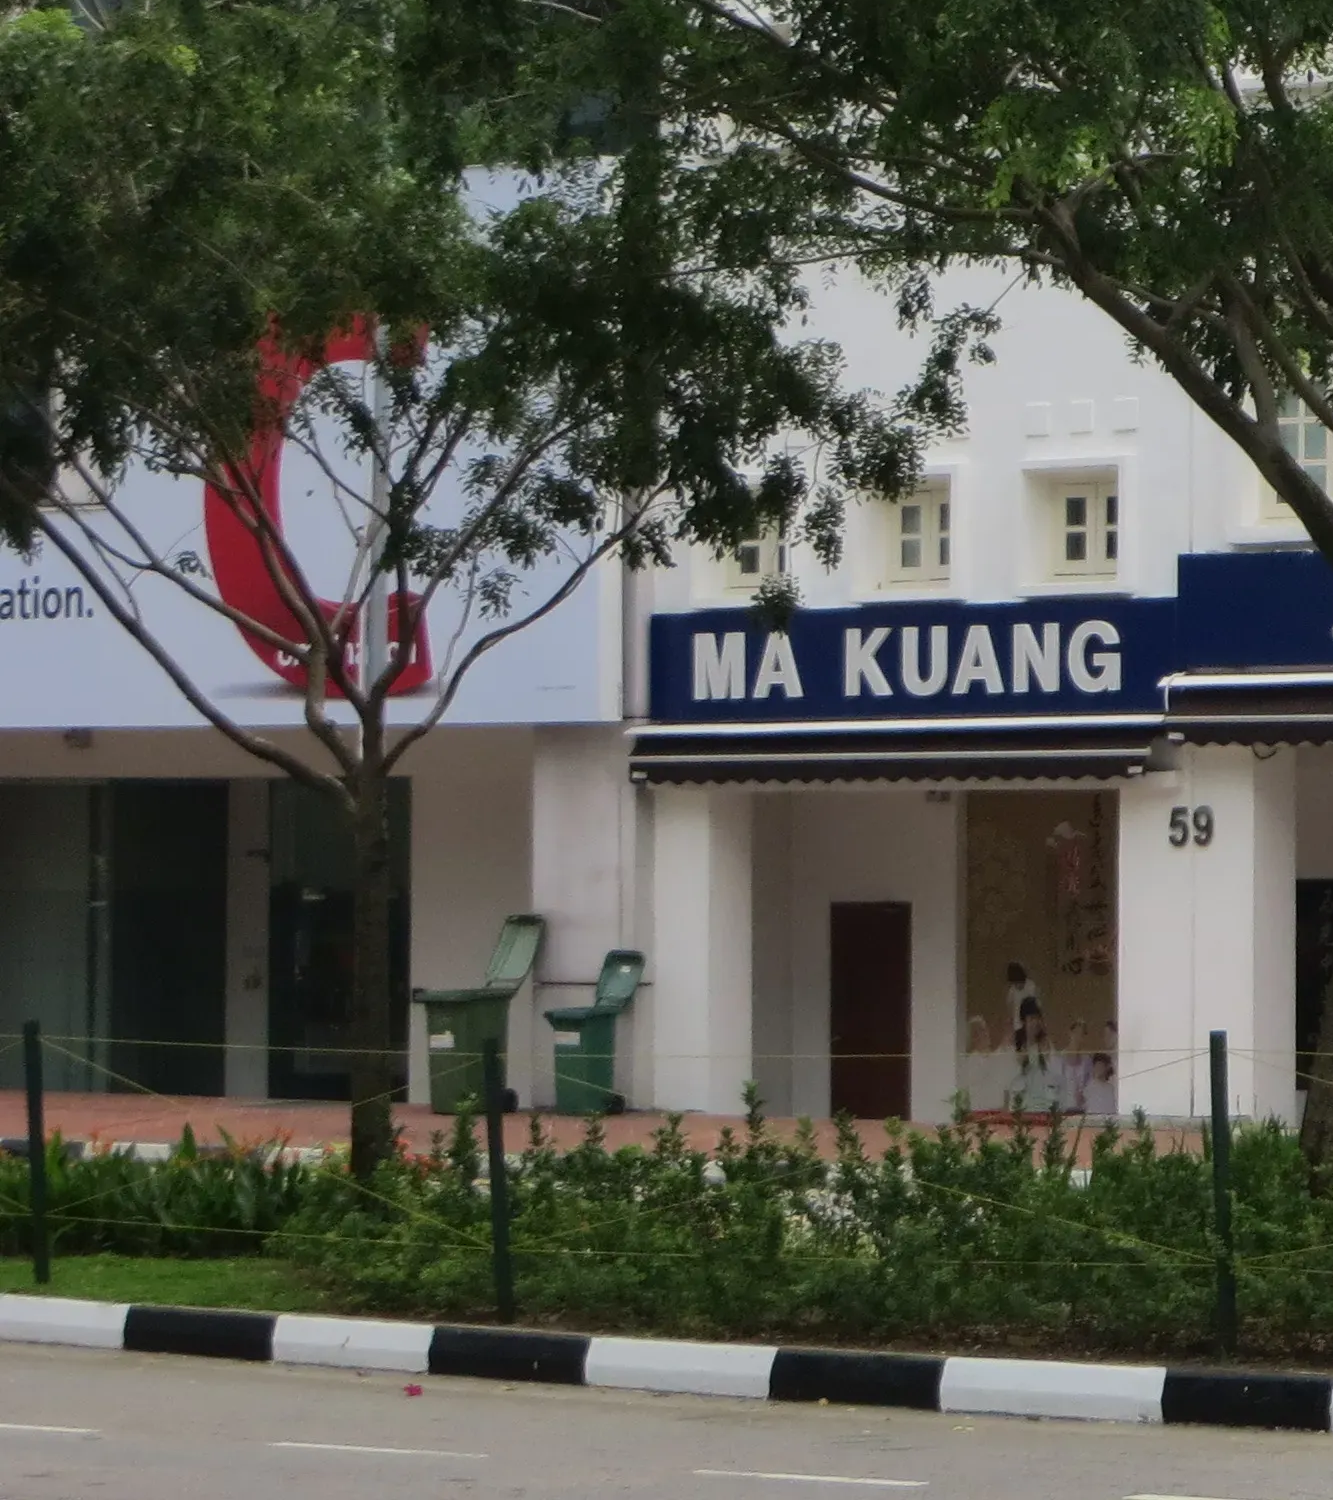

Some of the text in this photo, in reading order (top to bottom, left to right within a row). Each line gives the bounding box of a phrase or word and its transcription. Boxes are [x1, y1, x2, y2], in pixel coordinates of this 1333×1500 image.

[694, 620, 1121, 700] MA KUANG
[1168, 805, 1215, 848] 59
